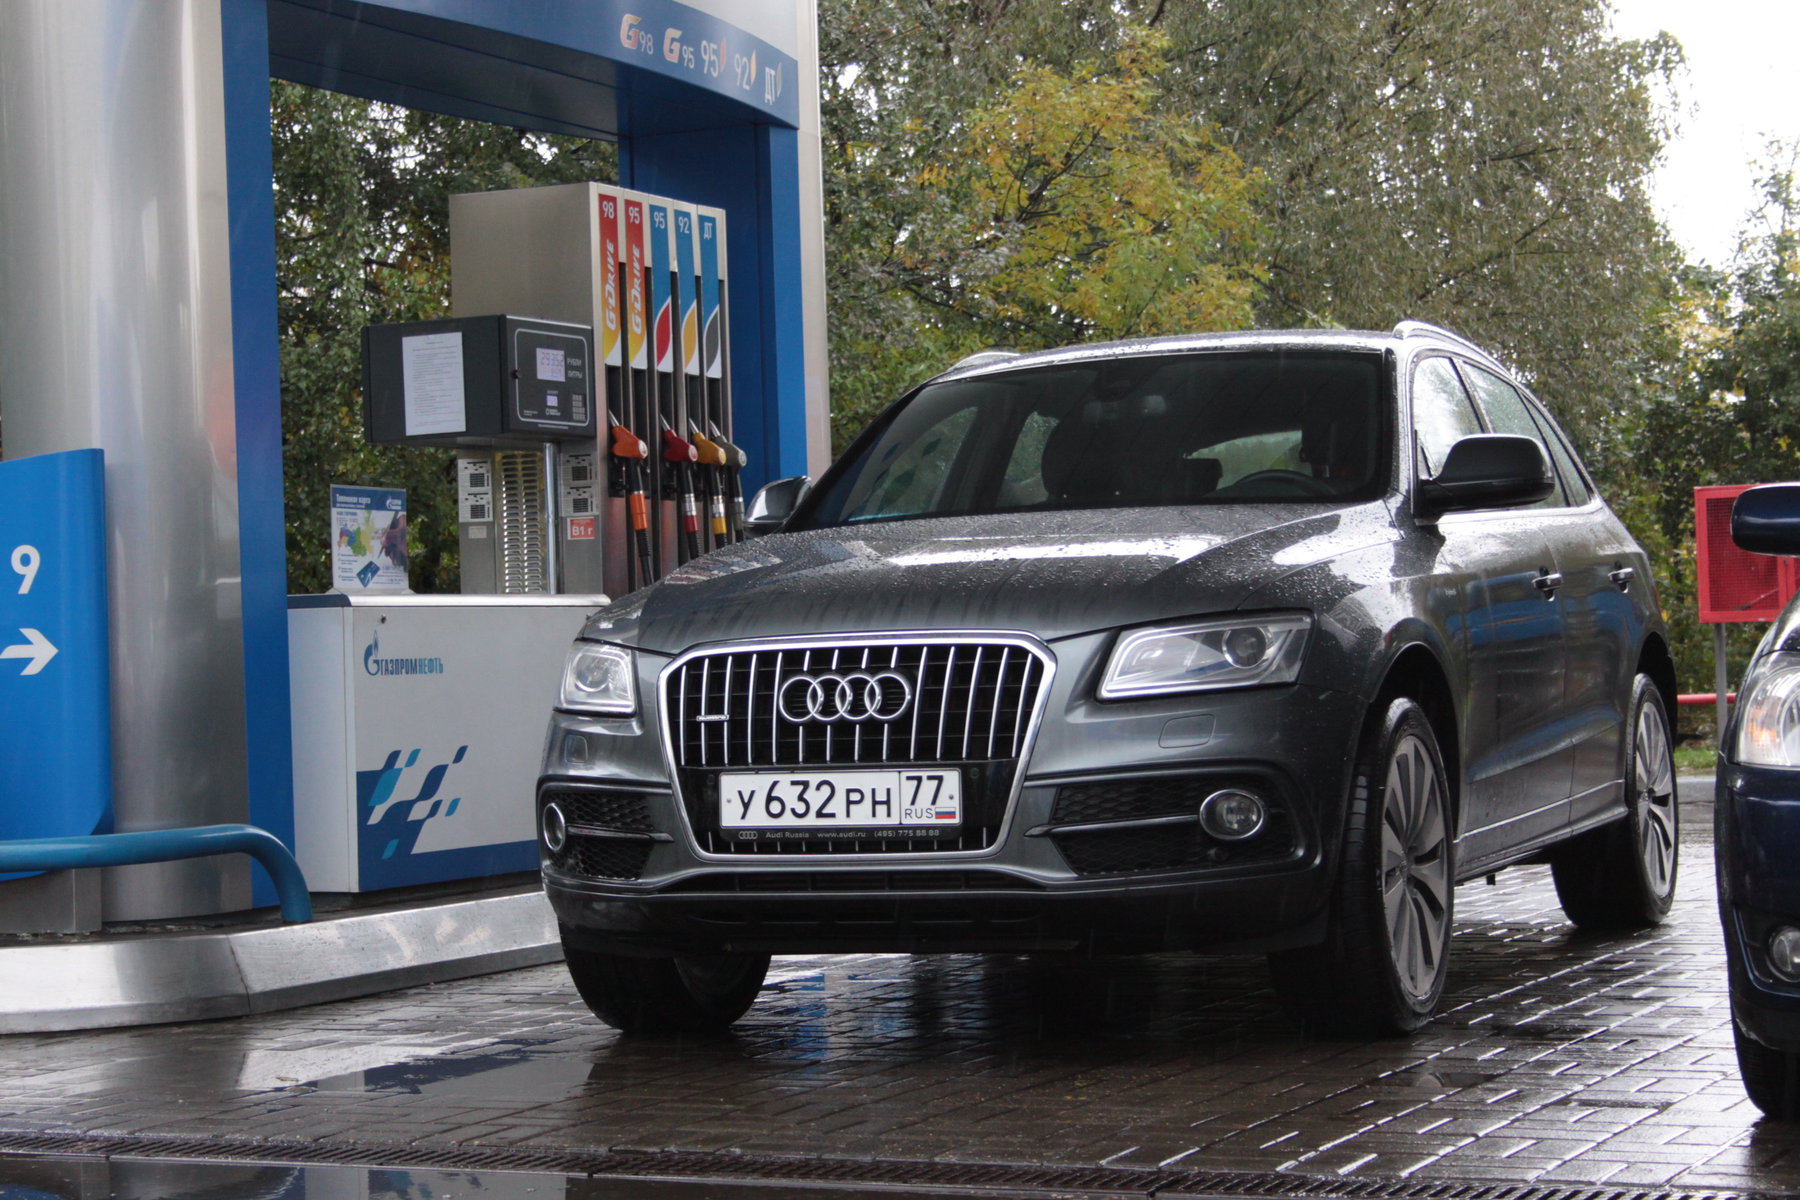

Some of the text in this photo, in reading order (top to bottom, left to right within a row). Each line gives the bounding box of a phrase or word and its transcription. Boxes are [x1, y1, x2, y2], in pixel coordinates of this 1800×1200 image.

[701, 40, 719, 78] 95
[734, 54, 750, 91] 92
[764, 67, 776, 105] ДТ
[602, 200, 614, 220] 98
[628, 206, 641, 225] 95
[654, 211, 665, 230] 95
[678, 216, 690, 235] 92
[703, 221, 713, 240] ДТ
[10, 544, 41, 595] 9
[905, 775, 944, 806] 77
[904, 807, 934, 819] RUS
[765, 831, 783, 839] Audi
[785, 831, 810, 839] Russia
